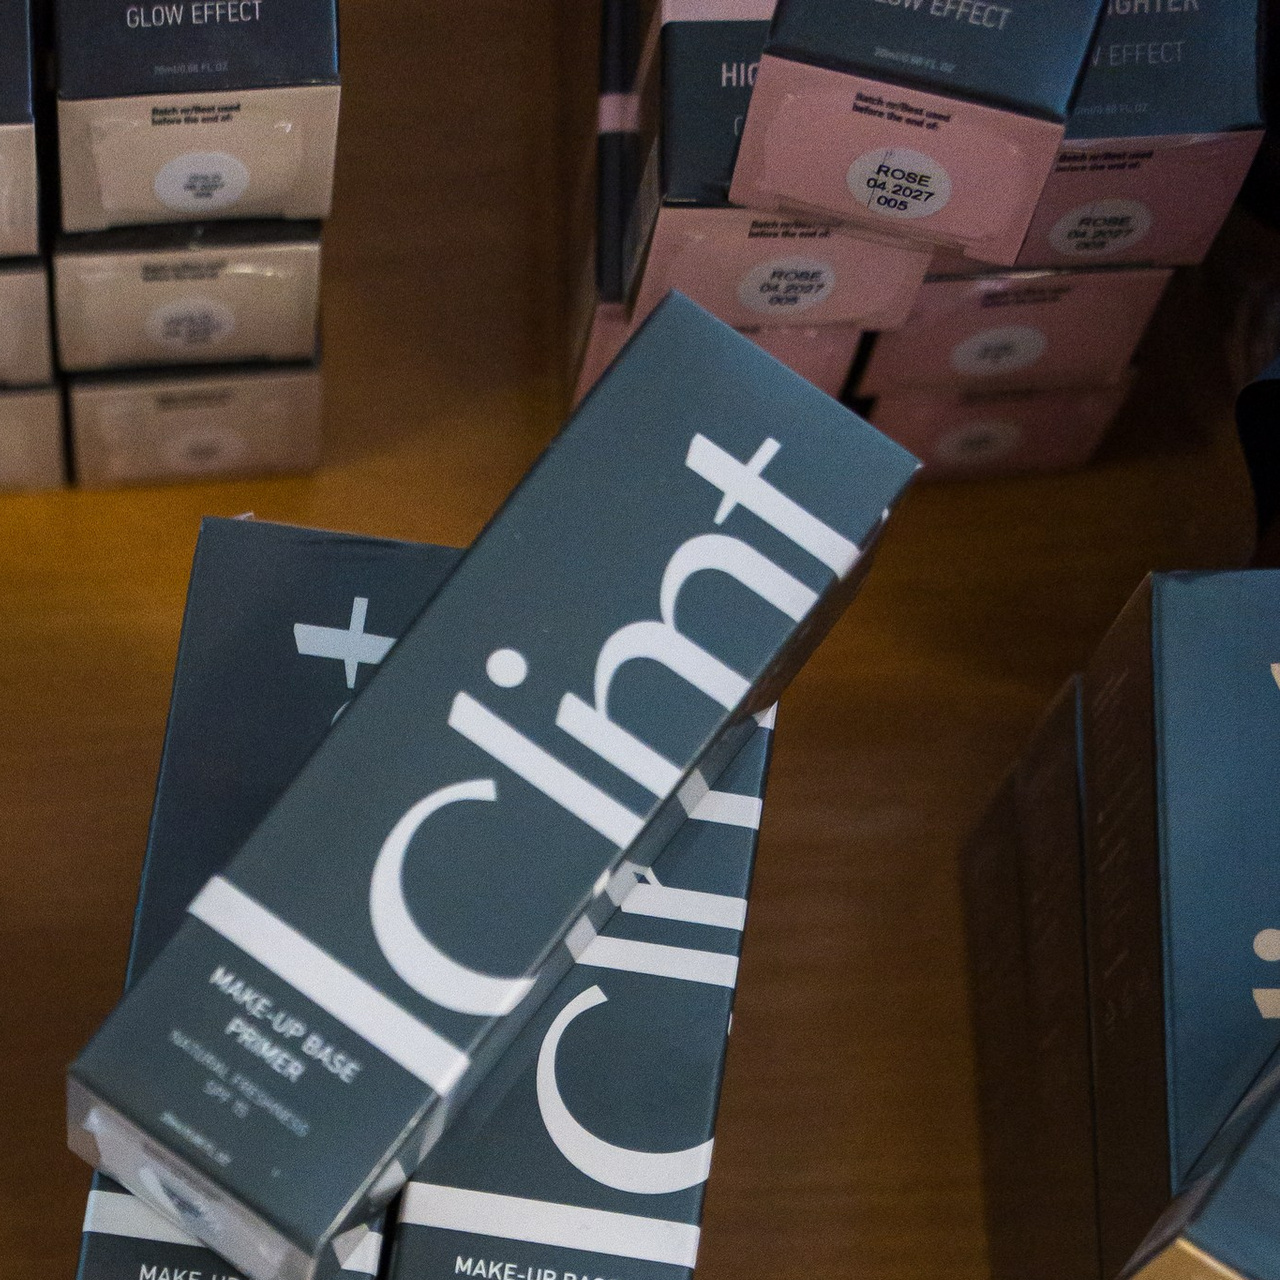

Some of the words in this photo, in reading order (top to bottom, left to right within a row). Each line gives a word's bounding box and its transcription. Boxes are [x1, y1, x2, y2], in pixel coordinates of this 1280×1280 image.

[126, 5, 184, 28] GLOW
[191, 0, 263, 25] EFFECT
[930, 0, 1013, 31] EFFECT
[866, 176, 936, 204] 04.2027
[874, 163, 932, 188] ROSE
[369, 433, 863, 1017] Climt
[209, 965, 308, 1038] MAKE-UP
[301, 1033, 362, 1084] BASE
[223, 1016, 308, 1083] PRIMER
